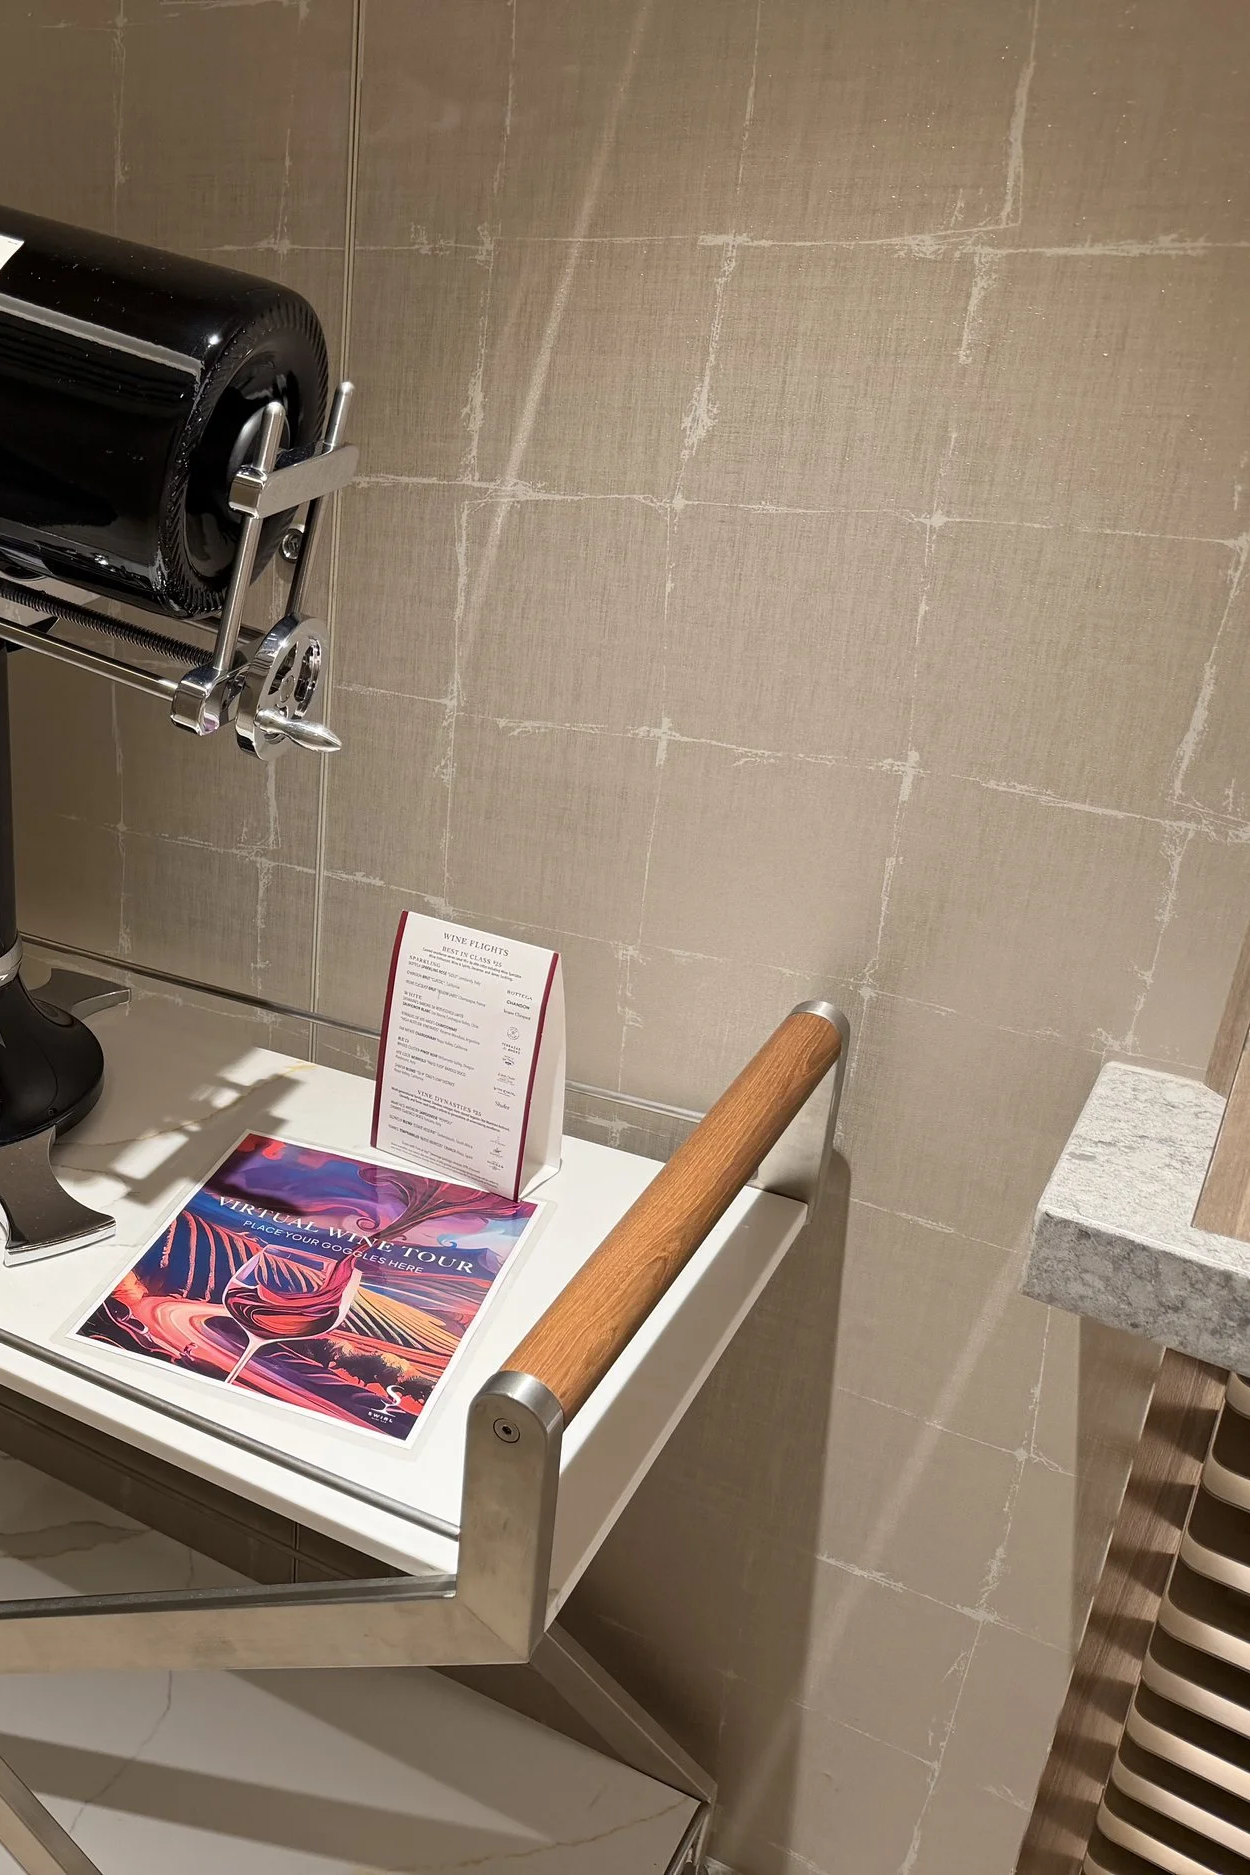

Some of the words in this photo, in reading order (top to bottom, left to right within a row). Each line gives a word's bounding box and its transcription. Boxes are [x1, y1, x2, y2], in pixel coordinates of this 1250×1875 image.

[441, 945, 459, 956] BEST
[459, 950, 468, 958] IN
[468, 953, 491, 965] CLASS
[443, 931, 468, 945] WINE
[468, 938, 509, 957] FLIGHTS
[408, 954, 441, 968] SPARKLING
[416, 1088, 433, 1100] VINE
[433, 1095, 471, 1113] DYNASTIES
[218, 1196, 319, 1233] VIRTUAL
[327, 1226, 393, 1253] WINE
[401, 1245, 474, 1274] TOUR
[243, 1220, 283, 1237] PLACE
[284, 1231, 320, 1247] YOUR
[321, 1241, 387, 1265] GOGGLES
[388, 1259, 425, 1274] HERE
[367, 1411, 393, 1423] SWIRL
